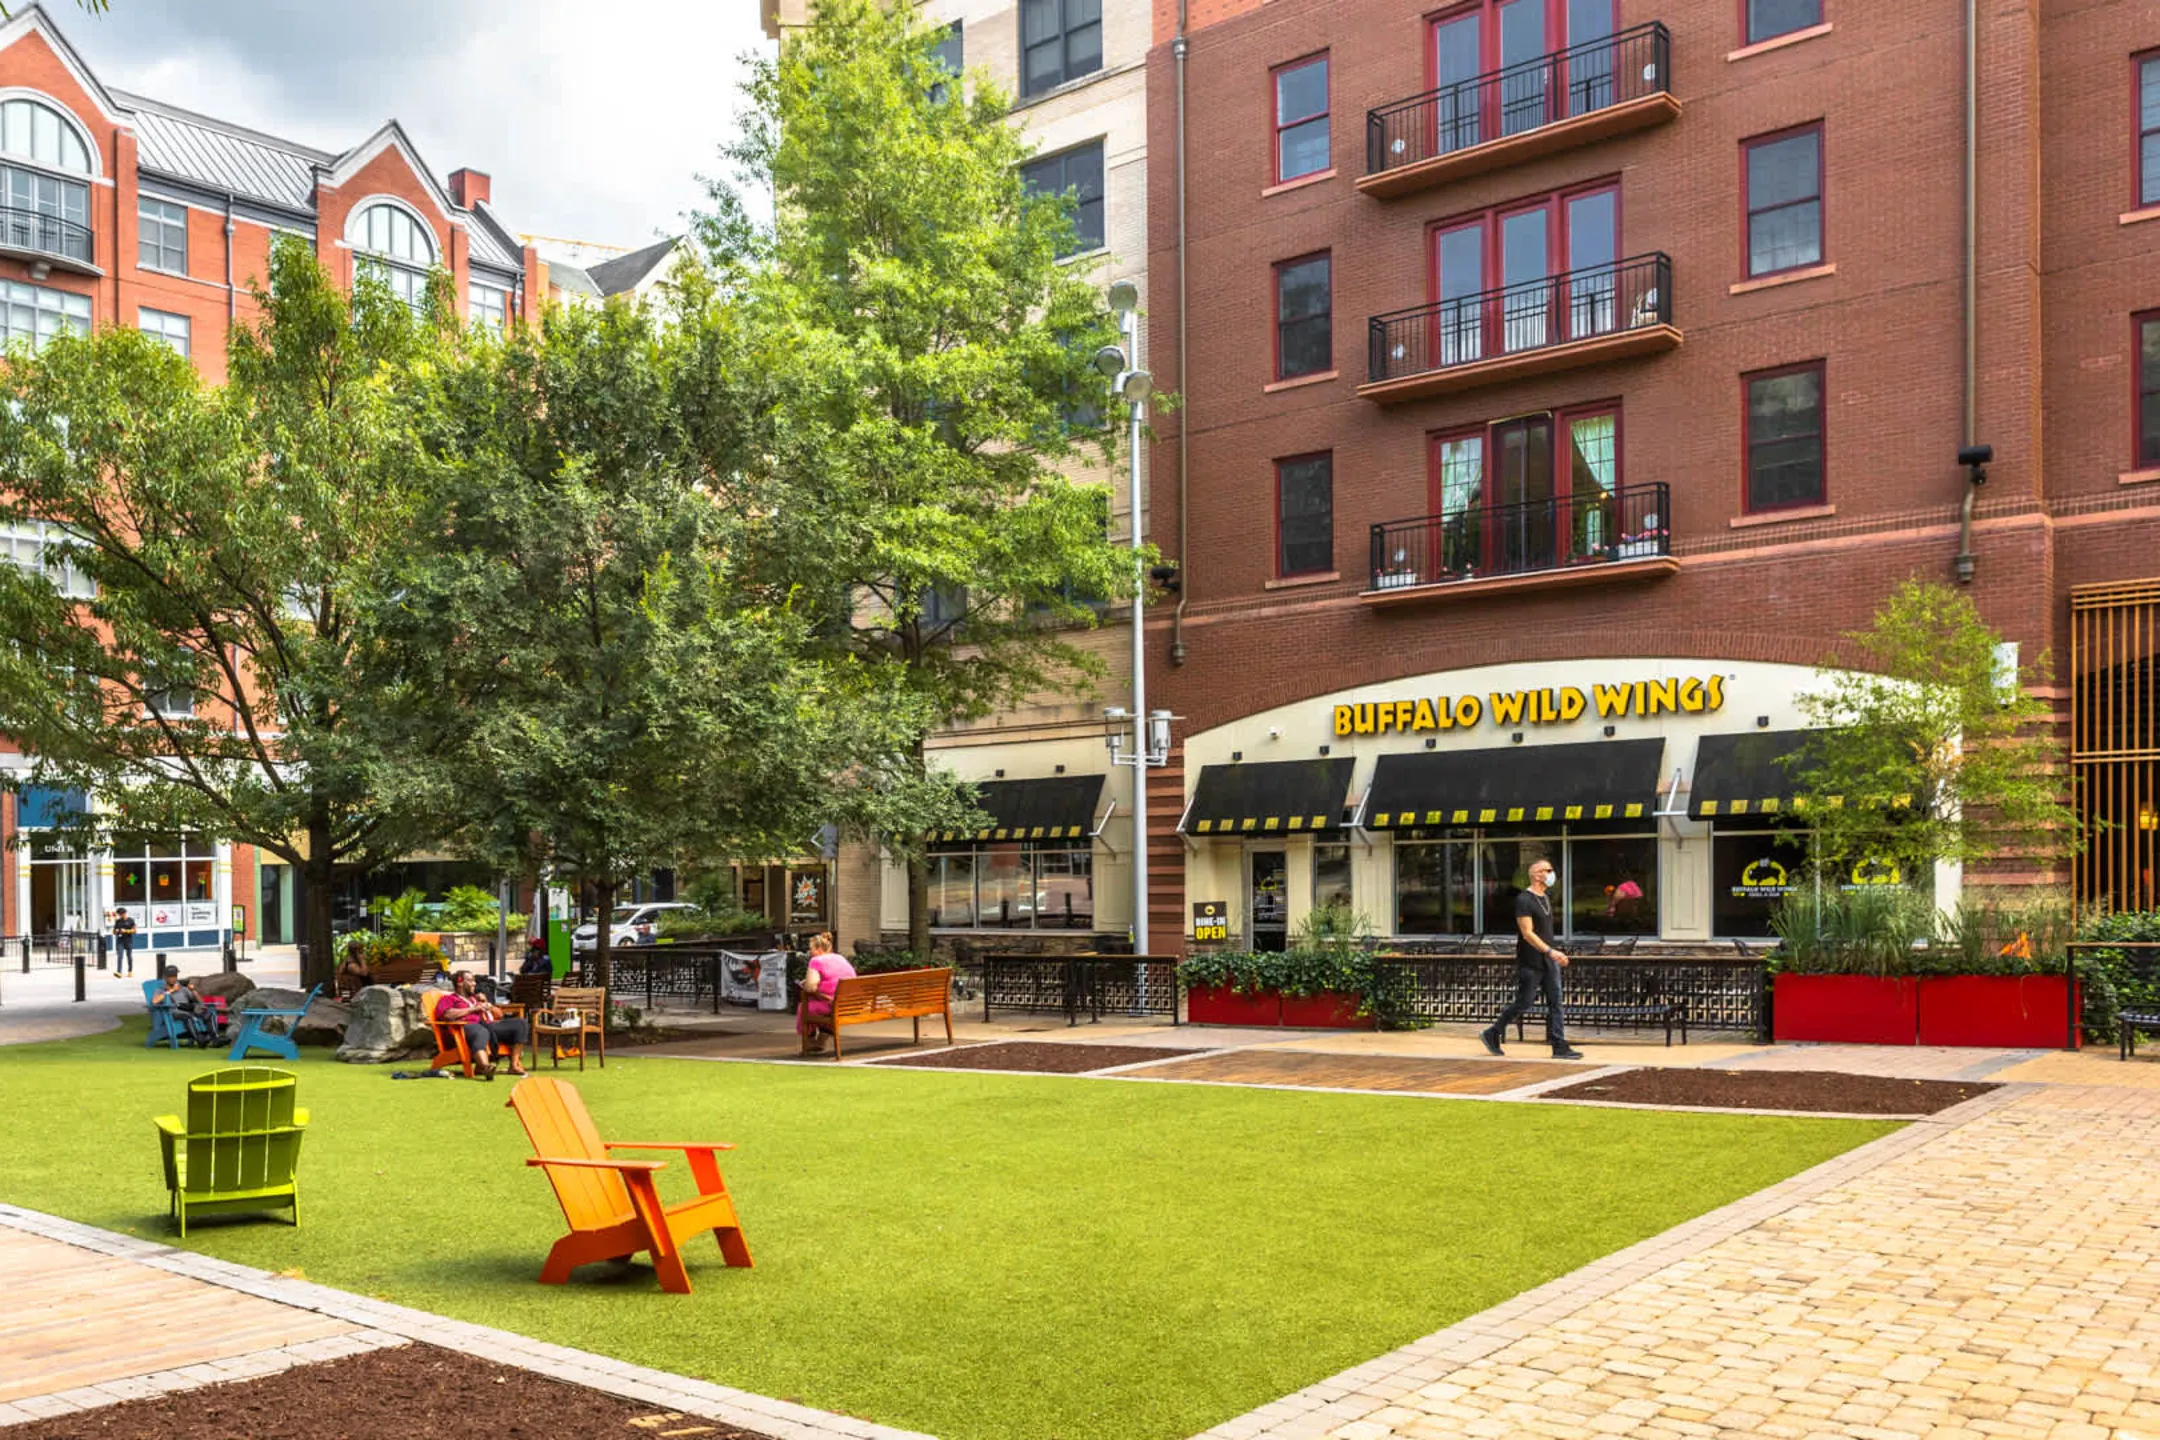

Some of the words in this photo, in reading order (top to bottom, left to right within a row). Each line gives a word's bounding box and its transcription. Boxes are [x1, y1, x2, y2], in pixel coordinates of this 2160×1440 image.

[1333, 694, 1482, 736] BUFFALO
[1489, 686, 1587, 725] WILD
[1592, 674, 1725, 717] WINGS
[1195, 926, 1227, 940] OPEN
